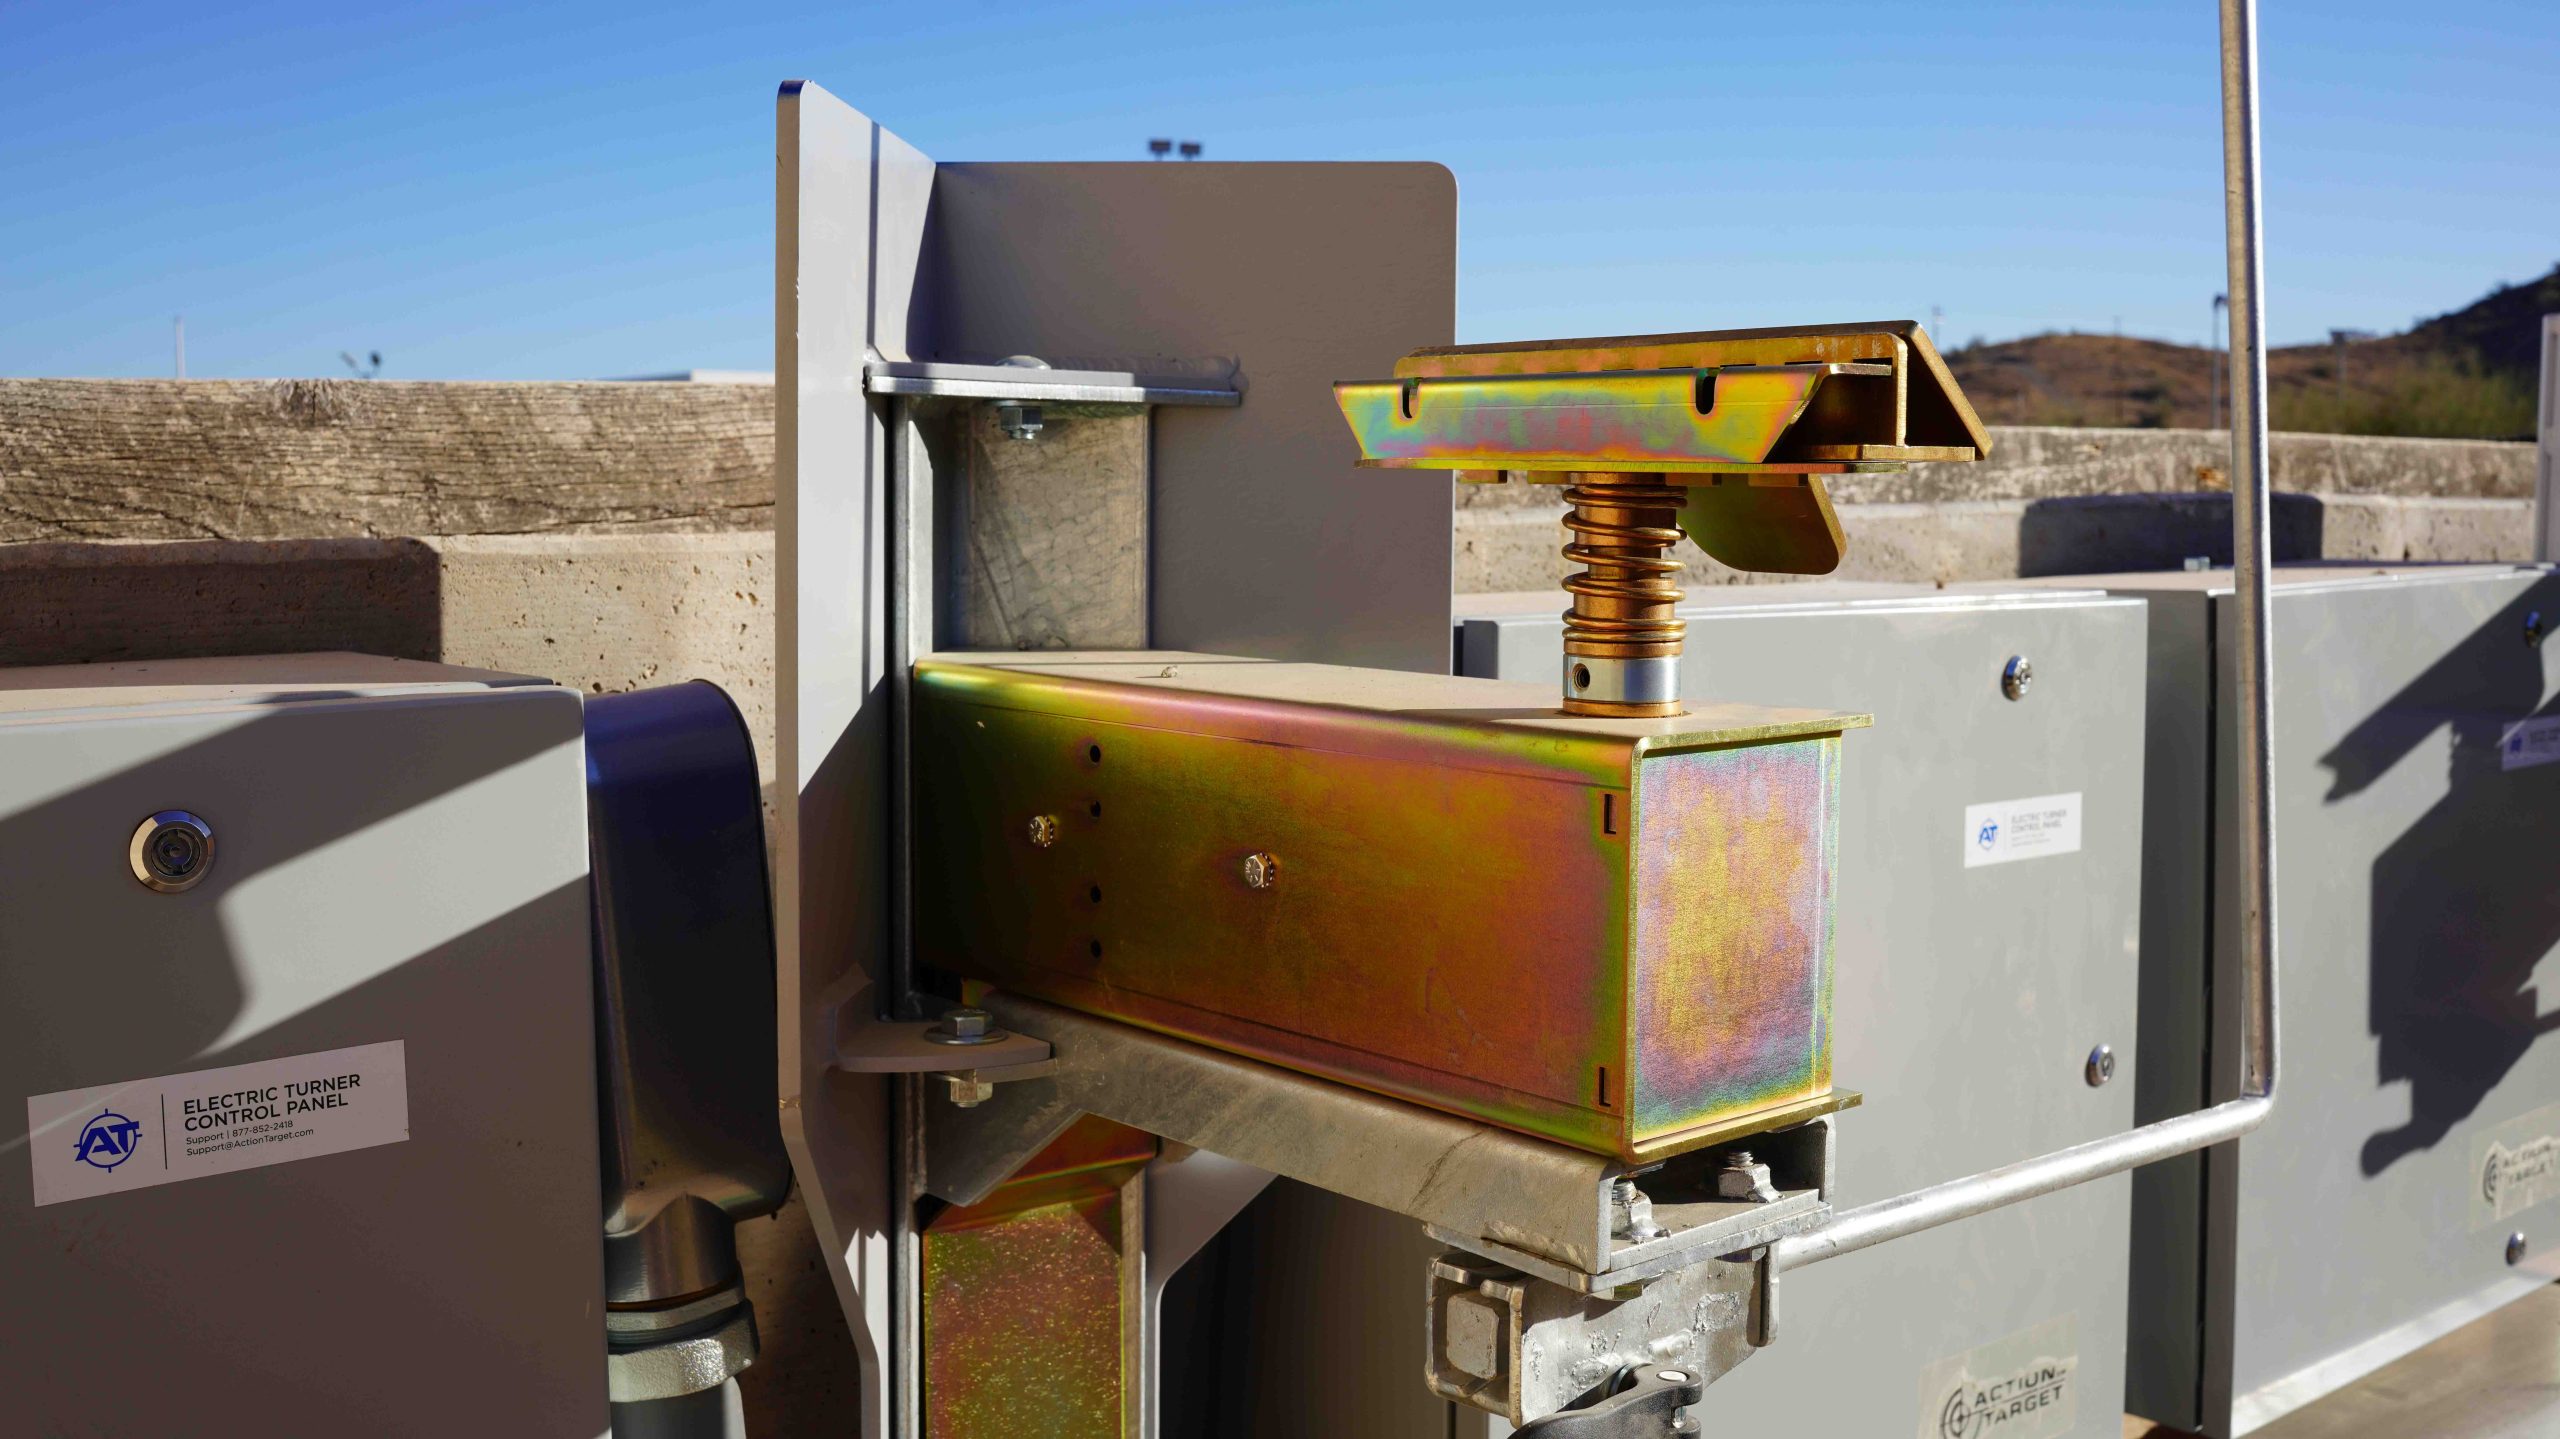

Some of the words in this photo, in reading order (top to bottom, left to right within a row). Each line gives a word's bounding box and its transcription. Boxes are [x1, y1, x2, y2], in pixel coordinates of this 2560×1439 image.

[184, 1086, 278, 1115] ELECTRIC
[284, 1073, 361, 1098] TURNER
[184, 1104, 281, 1132] CONTROL
[287, 1093, 349, 1115] PANEL
[74, 1120, 140, 1162] AT
[186, 1132, 224, 1146] Support
[232, 1120, 294, 1138] 877-852-2418
[187, 1127, 314, 1156] Support@ActionTarget.com
[1984, 1384, 2064, 1426] TARGET
